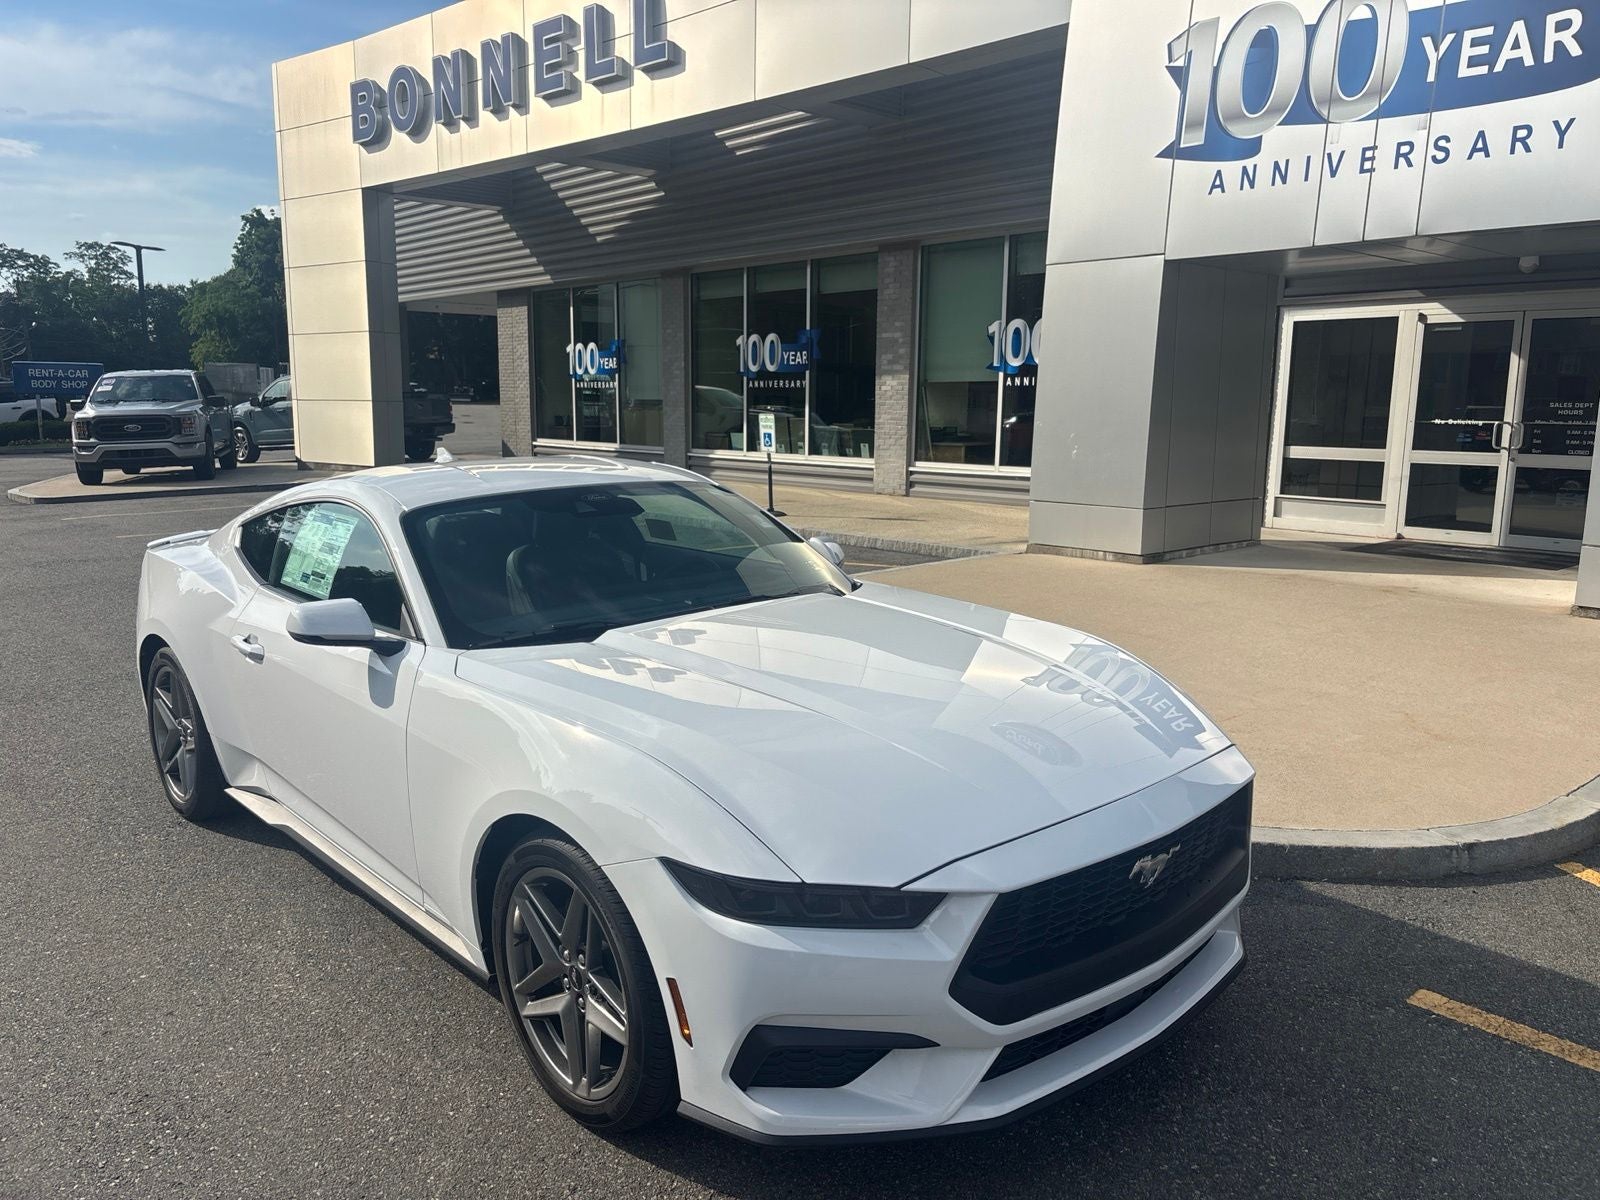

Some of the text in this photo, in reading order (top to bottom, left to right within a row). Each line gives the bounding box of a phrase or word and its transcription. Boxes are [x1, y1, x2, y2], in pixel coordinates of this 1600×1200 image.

[350, 0, 680, 145] BONNELL
[1168, 0, 1584, 148] 100 YEAR
[1207, 117, 1577, 196] ANNIVERSARY
[566, 342, 599, 375] 100
[736, 332, 808, 372] 100 YEAR
[28, 368, 89, 378] RENT-A-CAR
[31, 380, 57, 388] BODY
[61, 380, 88, 389] SHOP
[748, 380, 807, 388] ANNIVERSARY
